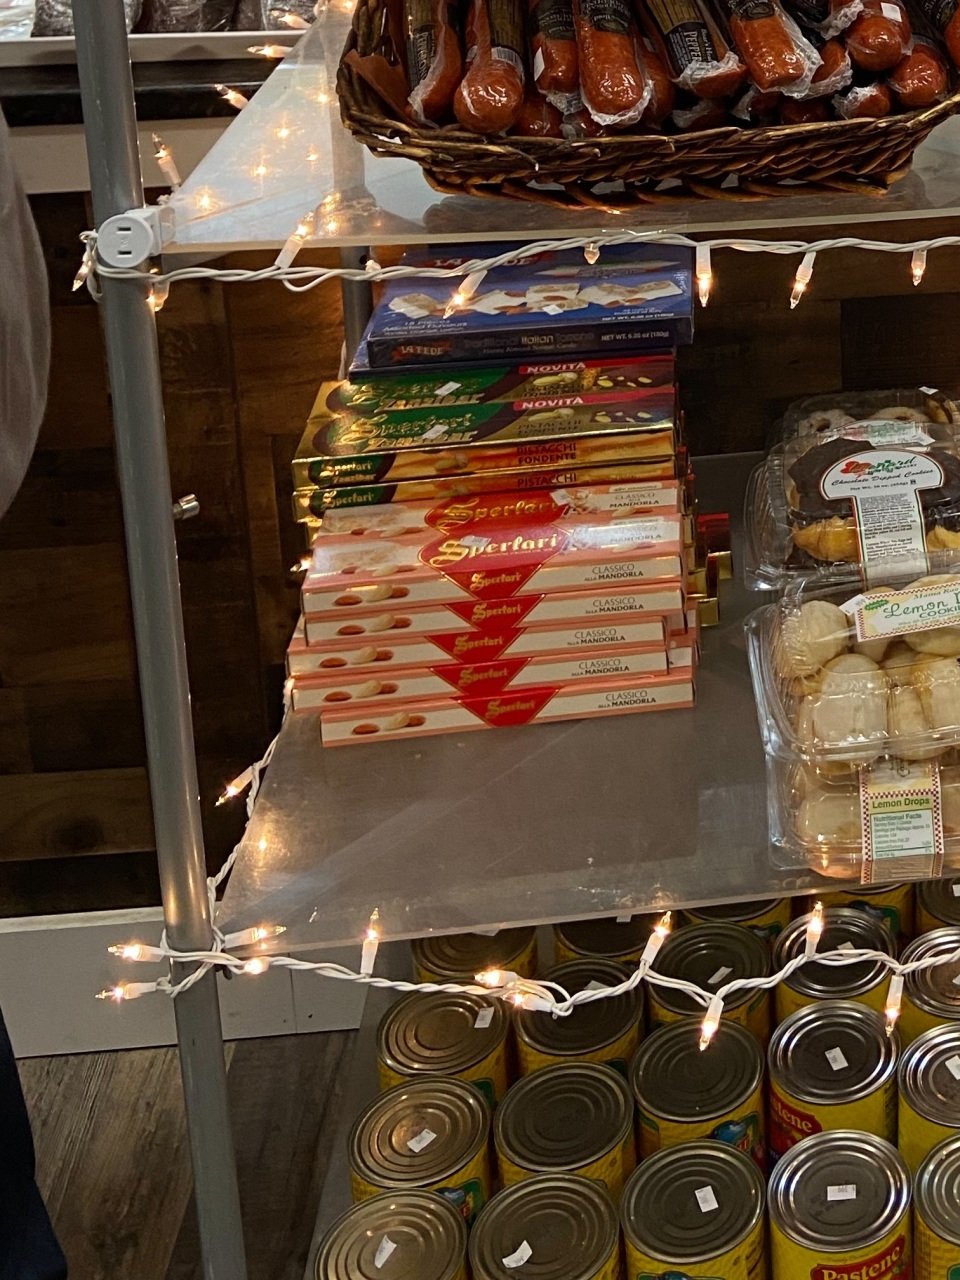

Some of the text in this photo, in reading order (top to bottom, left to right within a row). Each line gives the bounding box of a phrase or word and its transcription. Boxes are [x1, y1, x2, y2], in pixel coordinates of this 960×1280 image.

[591, 563, 634, 576] CLASSICO
[599, 570, 644, 580] MANDORLA
[470, 573, 521, 590] Sperlari
[883, 600, 948, 619] Lemon
[605, 690, 649, 702] CLASSICO
[612, 695, 657, 707] MANDORLA
[486, 700, 536, 719] Sperlari
[872, 800, 902, 809] Lemon
